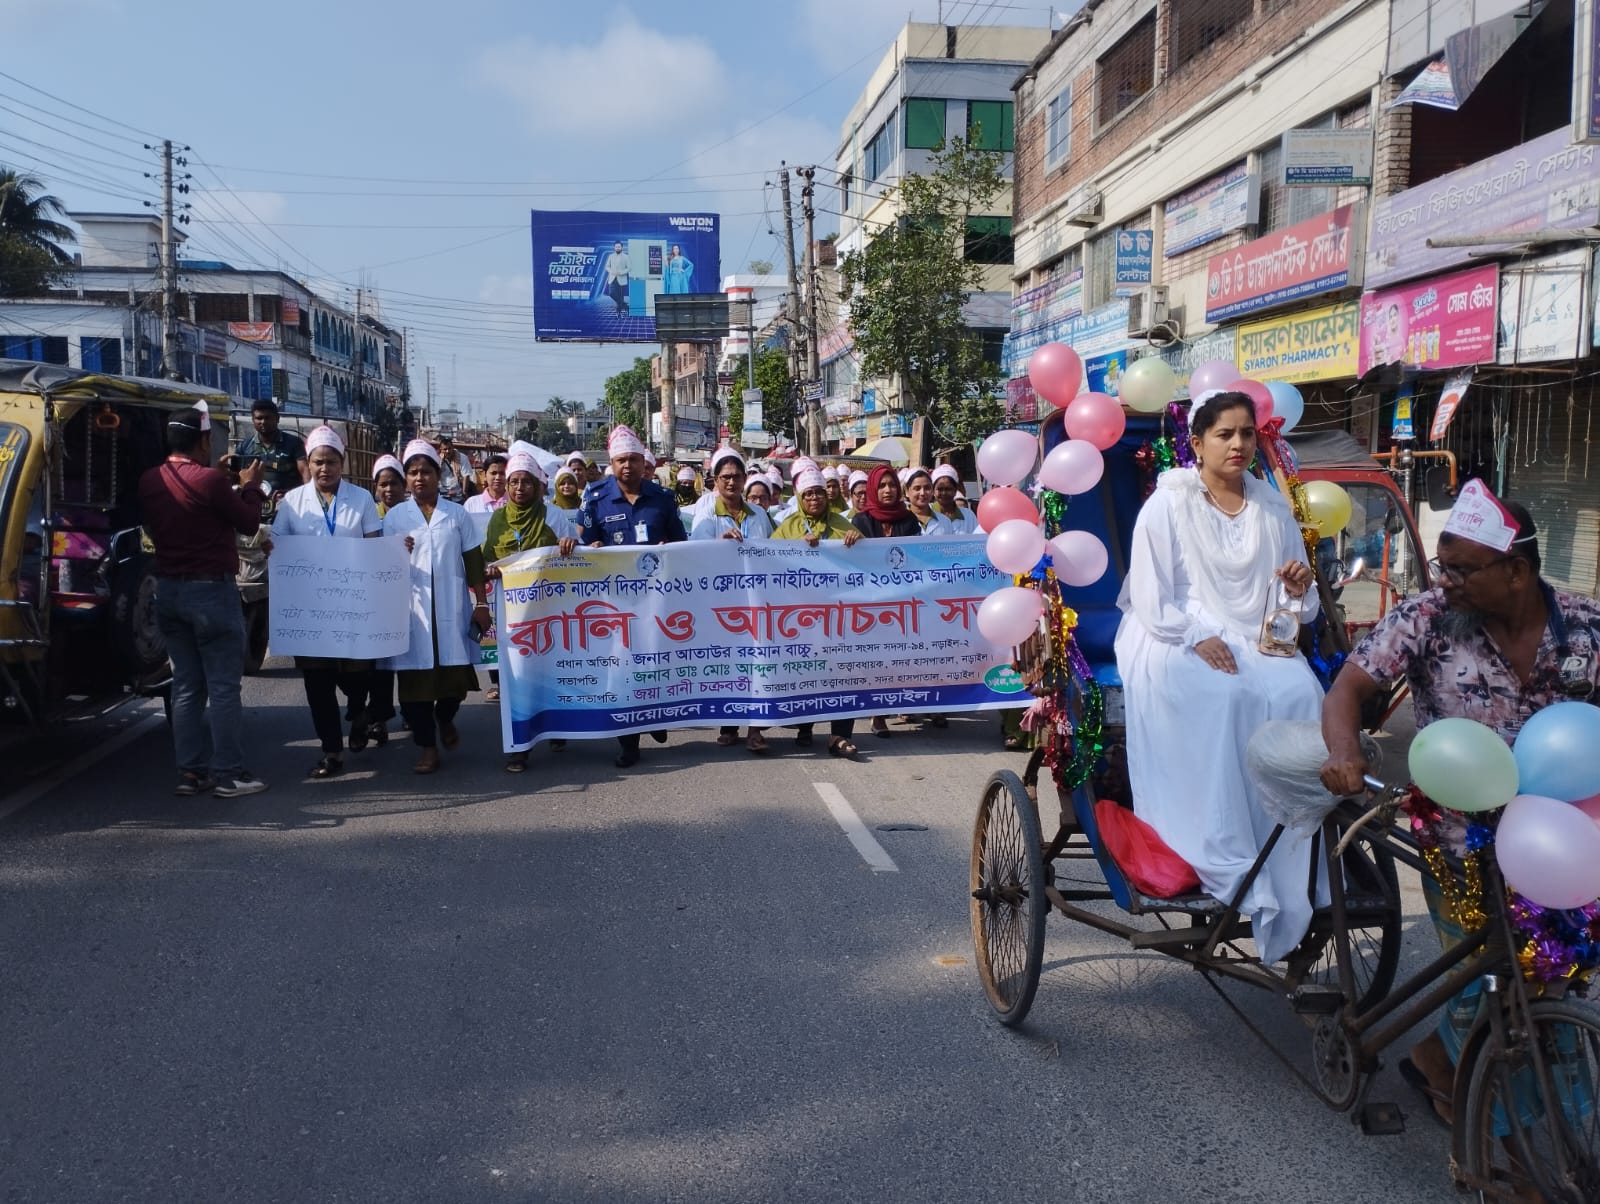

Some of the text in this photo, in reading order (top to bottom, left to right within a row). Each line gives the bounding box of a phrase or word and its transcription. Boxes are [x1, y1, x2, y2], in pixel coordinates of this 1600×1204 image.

[1376, 204, 1424, 235] ফাতেমা
[1536, 144, 1594, 182] সেন্টার
[669, 217, 713, 226] WALTON
[559, 253, 597, 265] স্টাইলে
[1310, 219, 1350, 273] সেন্টার
[548, 262, 584, 276] ফিচারে
[1118, 268, 1150, 280] সেন্টার
[1241, 321, 1293, 355] স্যারণ
[1294, 300, 1361, 346] ফার্মেসী
[1244, 344, 1340, 372] SYARON PHARMACY
[504, 578, 565, 605] আন্তর্জাতিক
[616, 575, 692, 597] দিবস-২০২৬
[698, 578, 708, 591] ও
[712, 573, 768, 594] ফ্লোরেন্স
[771, 567, 840, 590] নাইটিঙ্গেল
[844, 570, 865, 588] এর
[870, 568, 923, 587] ২০৬তম
[928, 563, 976, 585] জন্মদিন
[508, 600, 637, 656] র‍্যালি
[655, 611, 695, 641] ও
[711, 596, 925, 642] আলোচনা
[557, 658, 582, 670] প্রধান
[587, 656, 620, 668] অতিথি
[632, 651, 670, 666] জনাব
[676, 645, 731, 661] আতাউর
[737, 645, 781, 659] রহমান
[822, 643, 852, 655] মাননীয়
[855, 643, 880, 654] সংসদ
[931, 638, 969, 649] নড়াইল-২
[557, 675, 598, 686] সভাপতি
[632, 668, 670, 683] জনাব
[676, 664, 697, 678] ডাঃ
[703, 664, 730, 677] মোঃ
[735, 662, 778, 679] আব্দুল
[891, 658, 910, 668] সদর
[913, 655, 959, 667] হাসপাতাল,
[557, 694, 574, 704] সহ
[576, 692, 618, 704] সভাপতি
[666, 679, 693, 697] রানী
[762, 682, 797, 694] ভারপ্রাপ্ত
[799, 680, 818, 690] সেবা
[874, 675, 894, 685] সদর
[897, 672, 943, 683] হাসপাতাল,
[610, 703, 703, 724] আয়োজনে
[722, 701, 772, 715] জেলা
[776, 692, 865, 714] হাসপাতাল,
